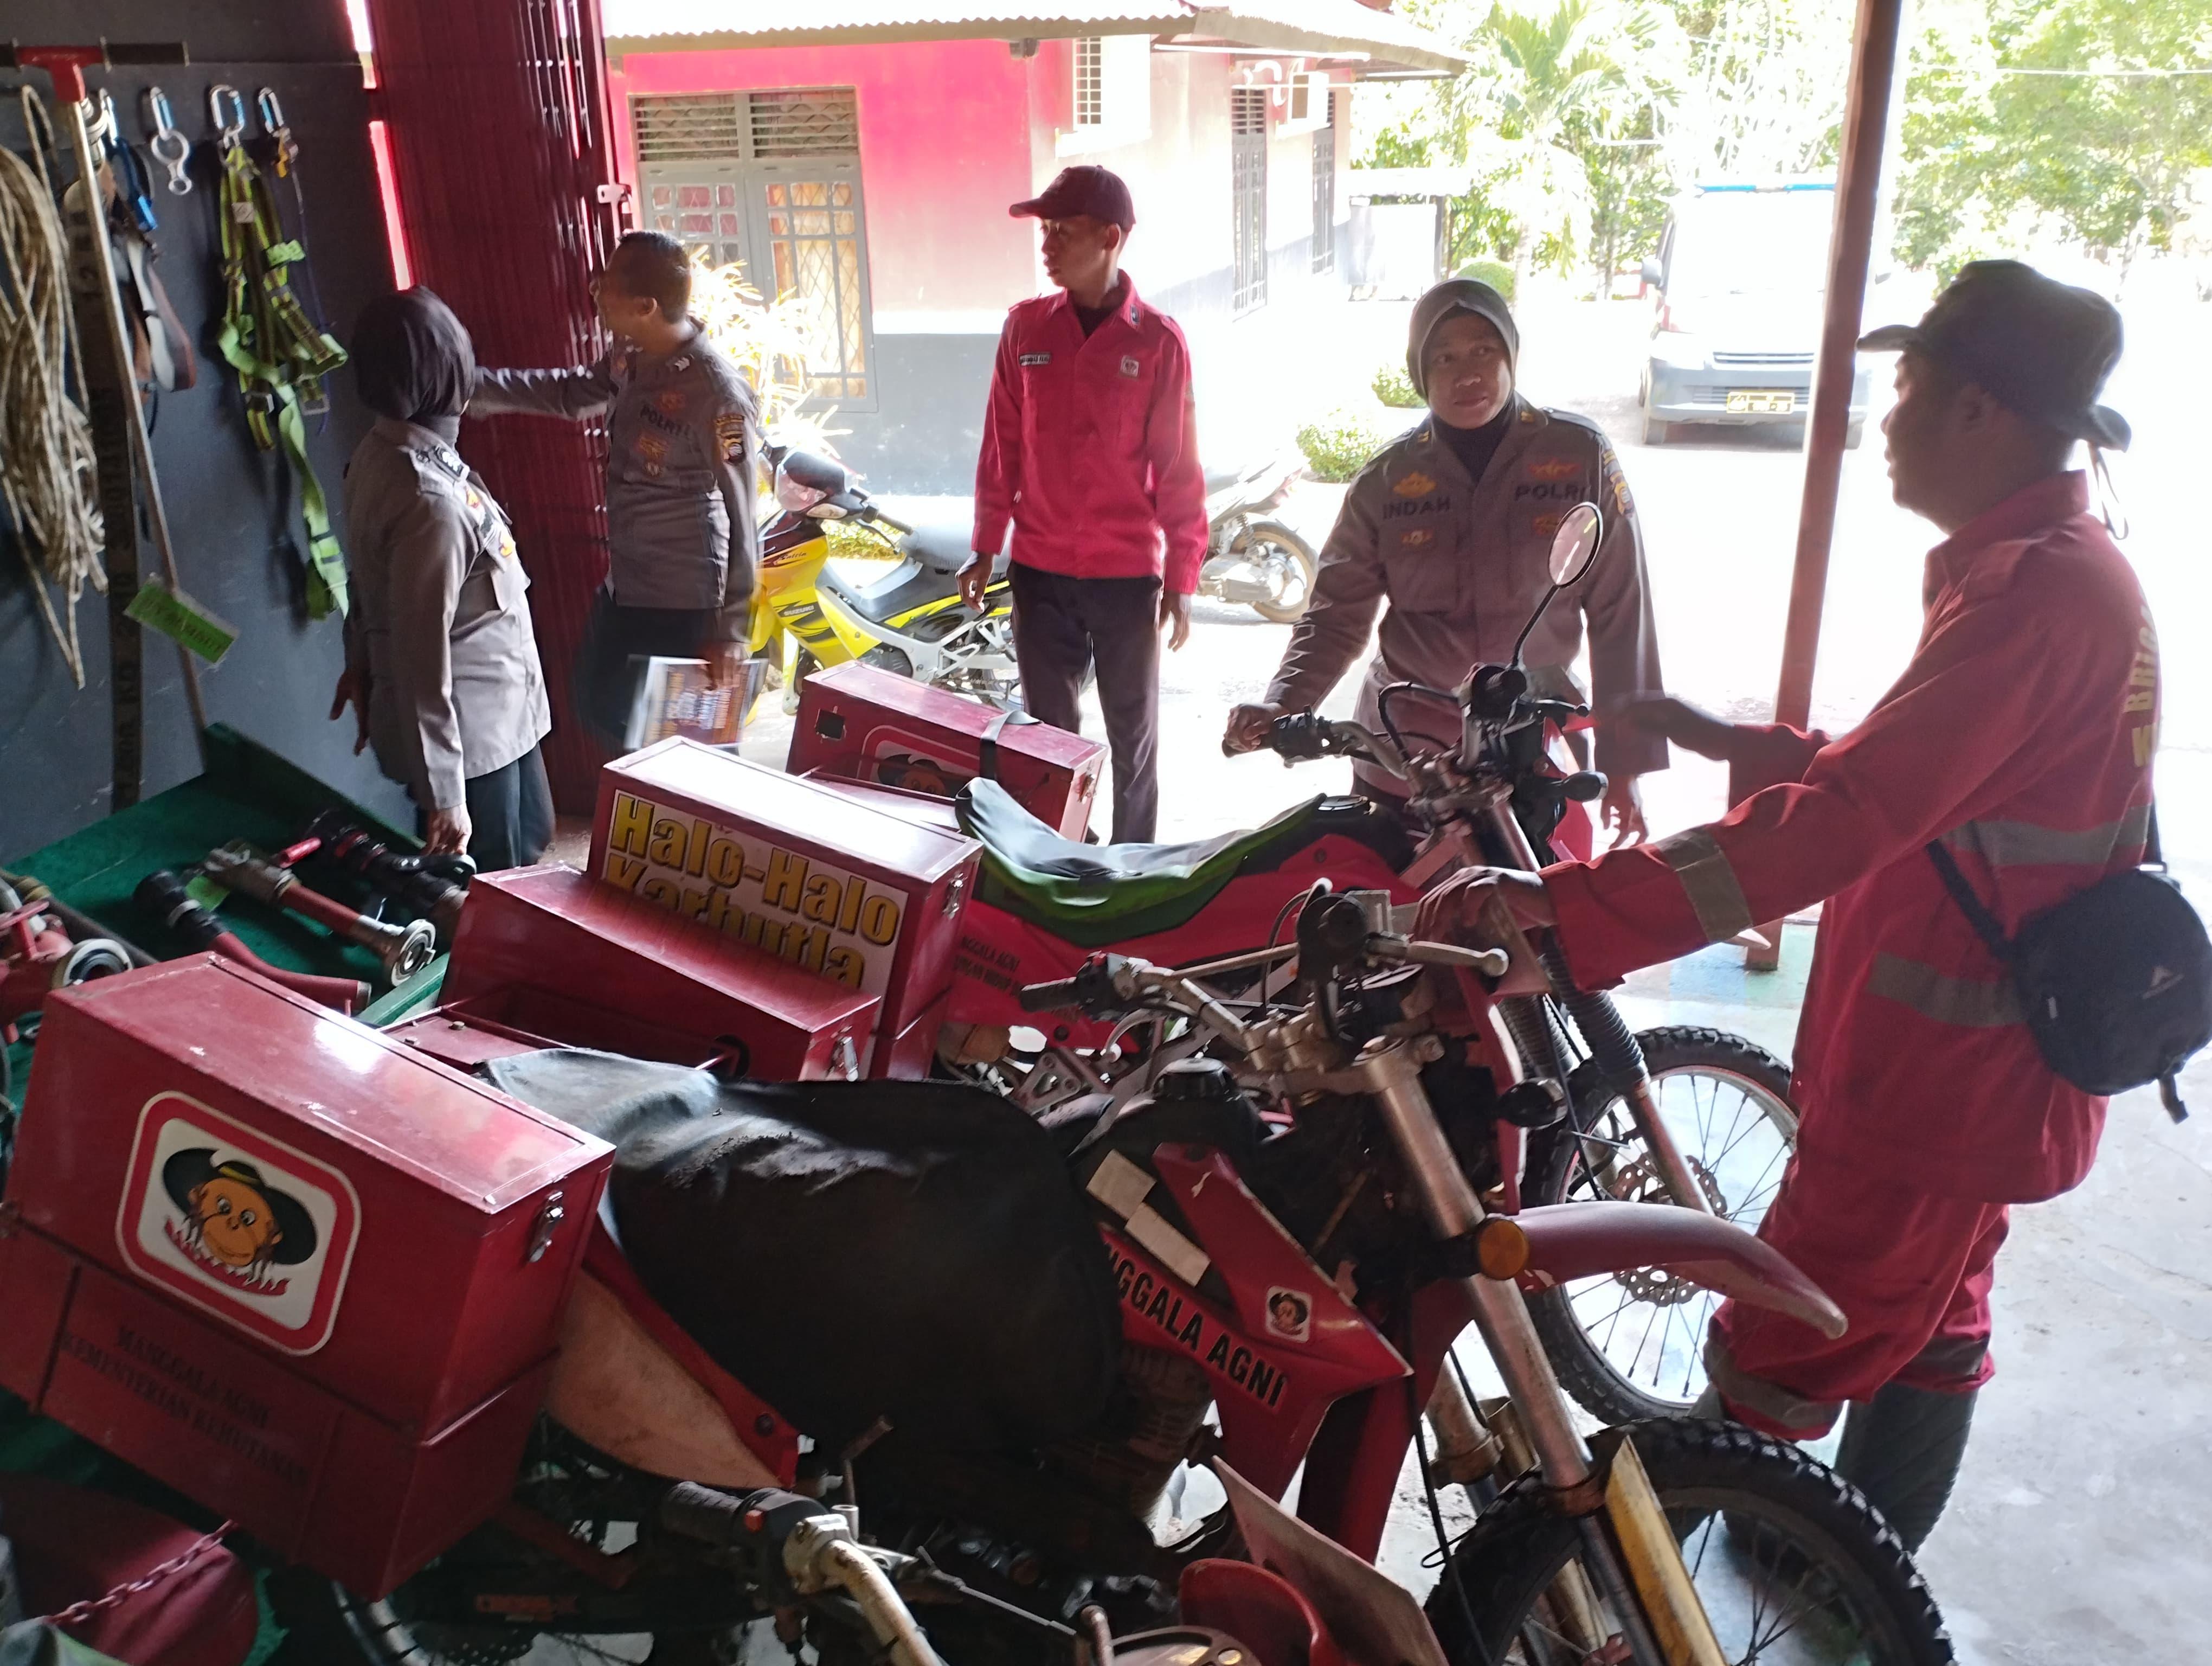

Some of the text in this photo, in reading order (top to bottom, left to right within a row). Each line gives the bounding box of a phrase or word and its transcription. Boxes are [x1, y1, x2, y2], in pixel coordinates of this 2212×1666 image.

[1515, 484, 1586, 502] POLRI
[1382, 496, 1450, 520] INDAH
[783, 605, 814, 616] SUZUKI
[609, 793, 900, 946] Halo-Halo
[1206, 1331, 1289, 1407] AGNI
